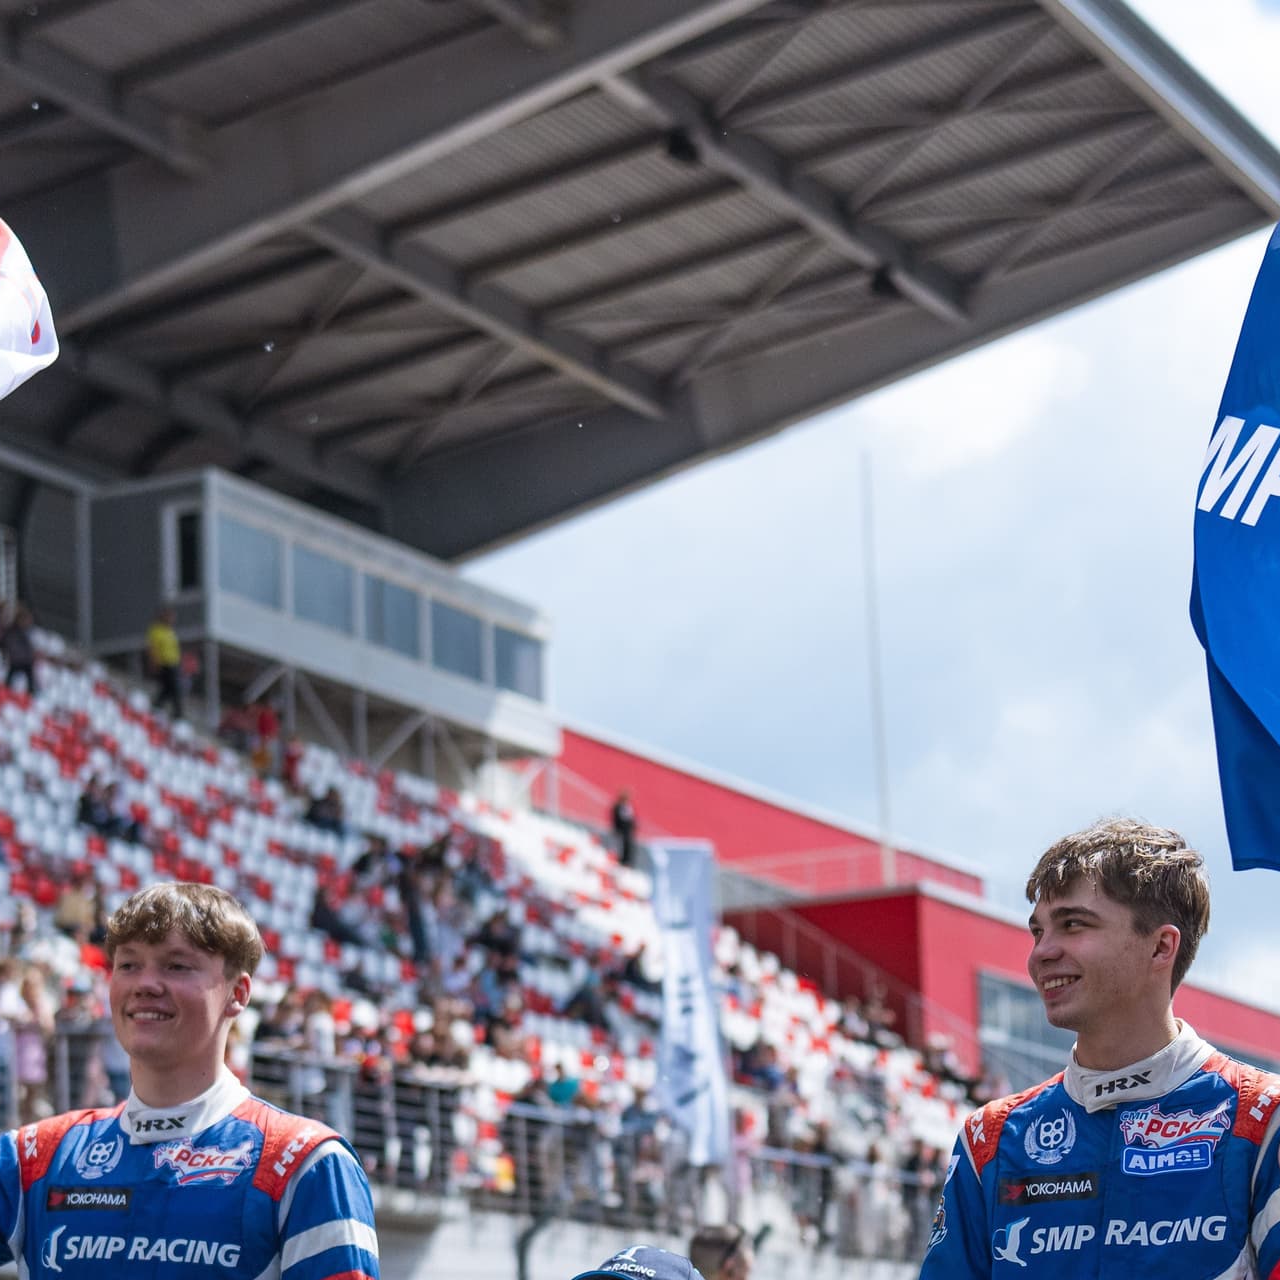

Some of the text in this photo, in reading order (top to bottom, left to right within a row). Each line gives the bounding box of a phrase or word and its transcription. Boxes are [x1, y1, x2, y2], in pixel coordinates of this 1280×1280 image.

[1095, 1069, 1152, 1097] HRX
[135, 1115, 186, 1133] HRX
[1128, 1148, 1207, 1170] AIMOL
[1025, 1179, 1093, 1197] YOKOHAMA
[66, 1193, 127, 1206] YOKOHAMA
[1030, 1215, 1228, 1255] SMP RACING
[64, 1235, 241, 1268] SMP RACING
[612, 1263, 657, 1278] RACING
